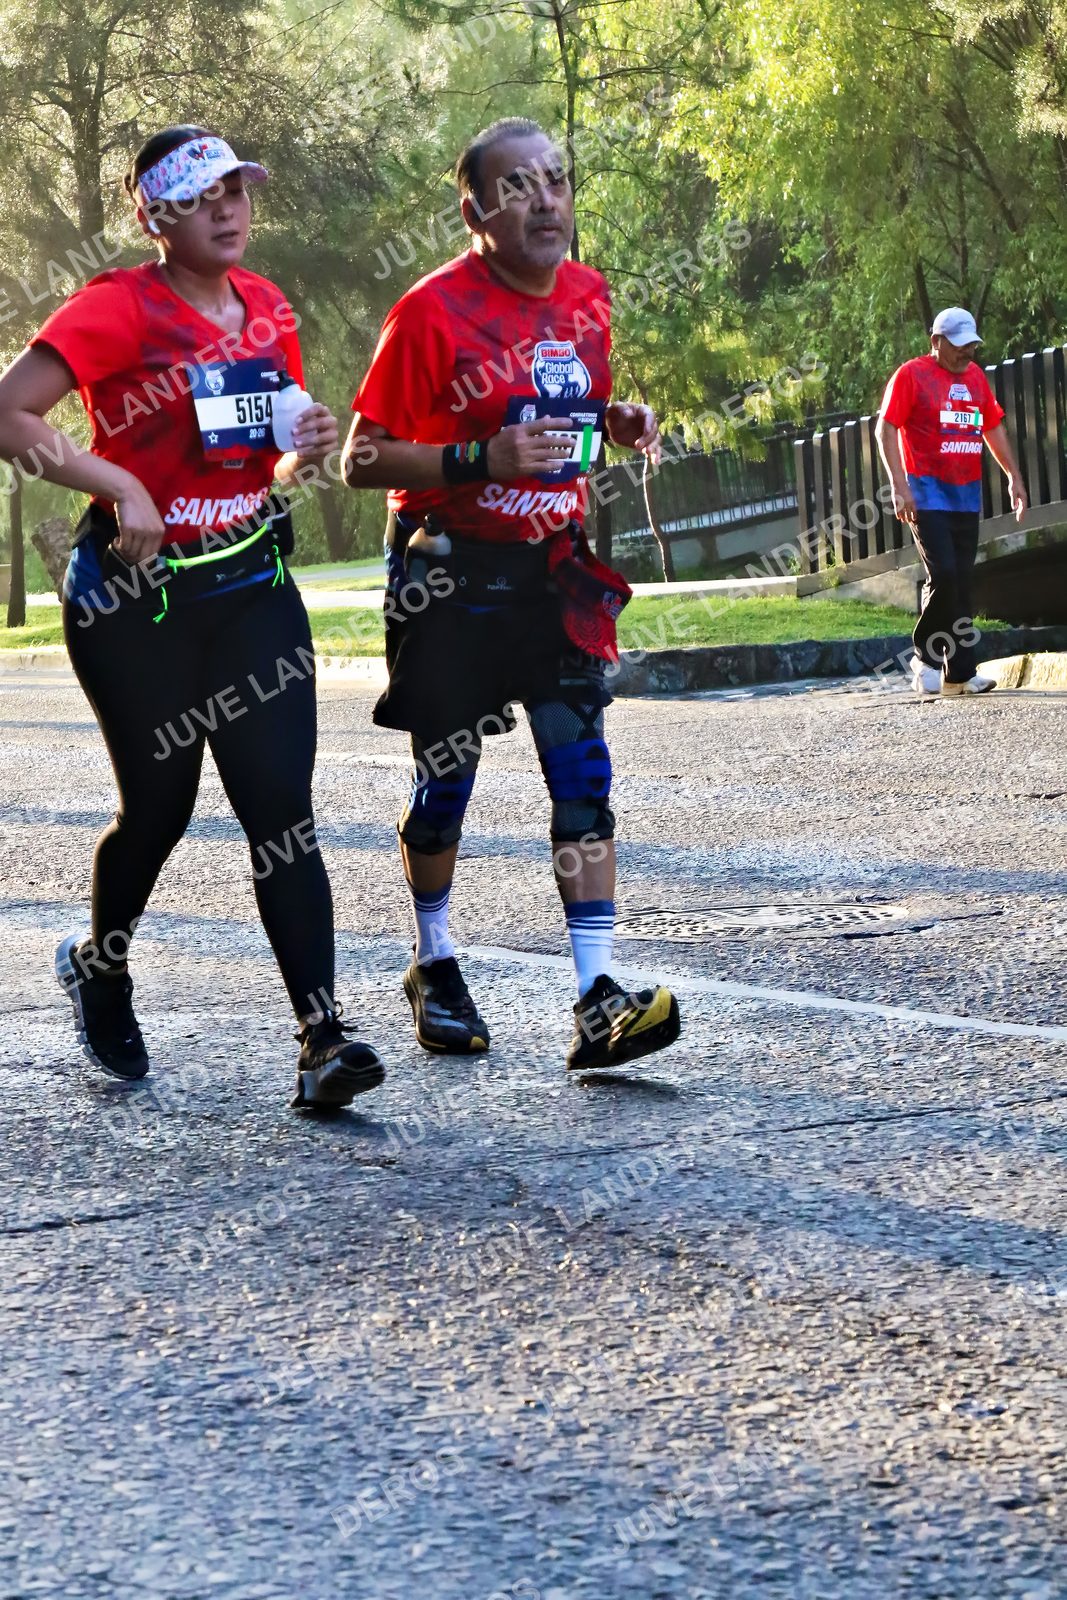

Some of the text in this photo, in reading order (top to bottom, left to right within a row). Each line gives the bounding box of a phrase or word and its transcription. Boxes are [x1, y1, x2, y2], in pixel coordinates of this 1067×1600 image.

[541, 348, 570, 357] BIMBO
[545, 362, 573, 374] Global
[541, 373, 565, 384] Race
[235, 394, 273, 424] 5154
